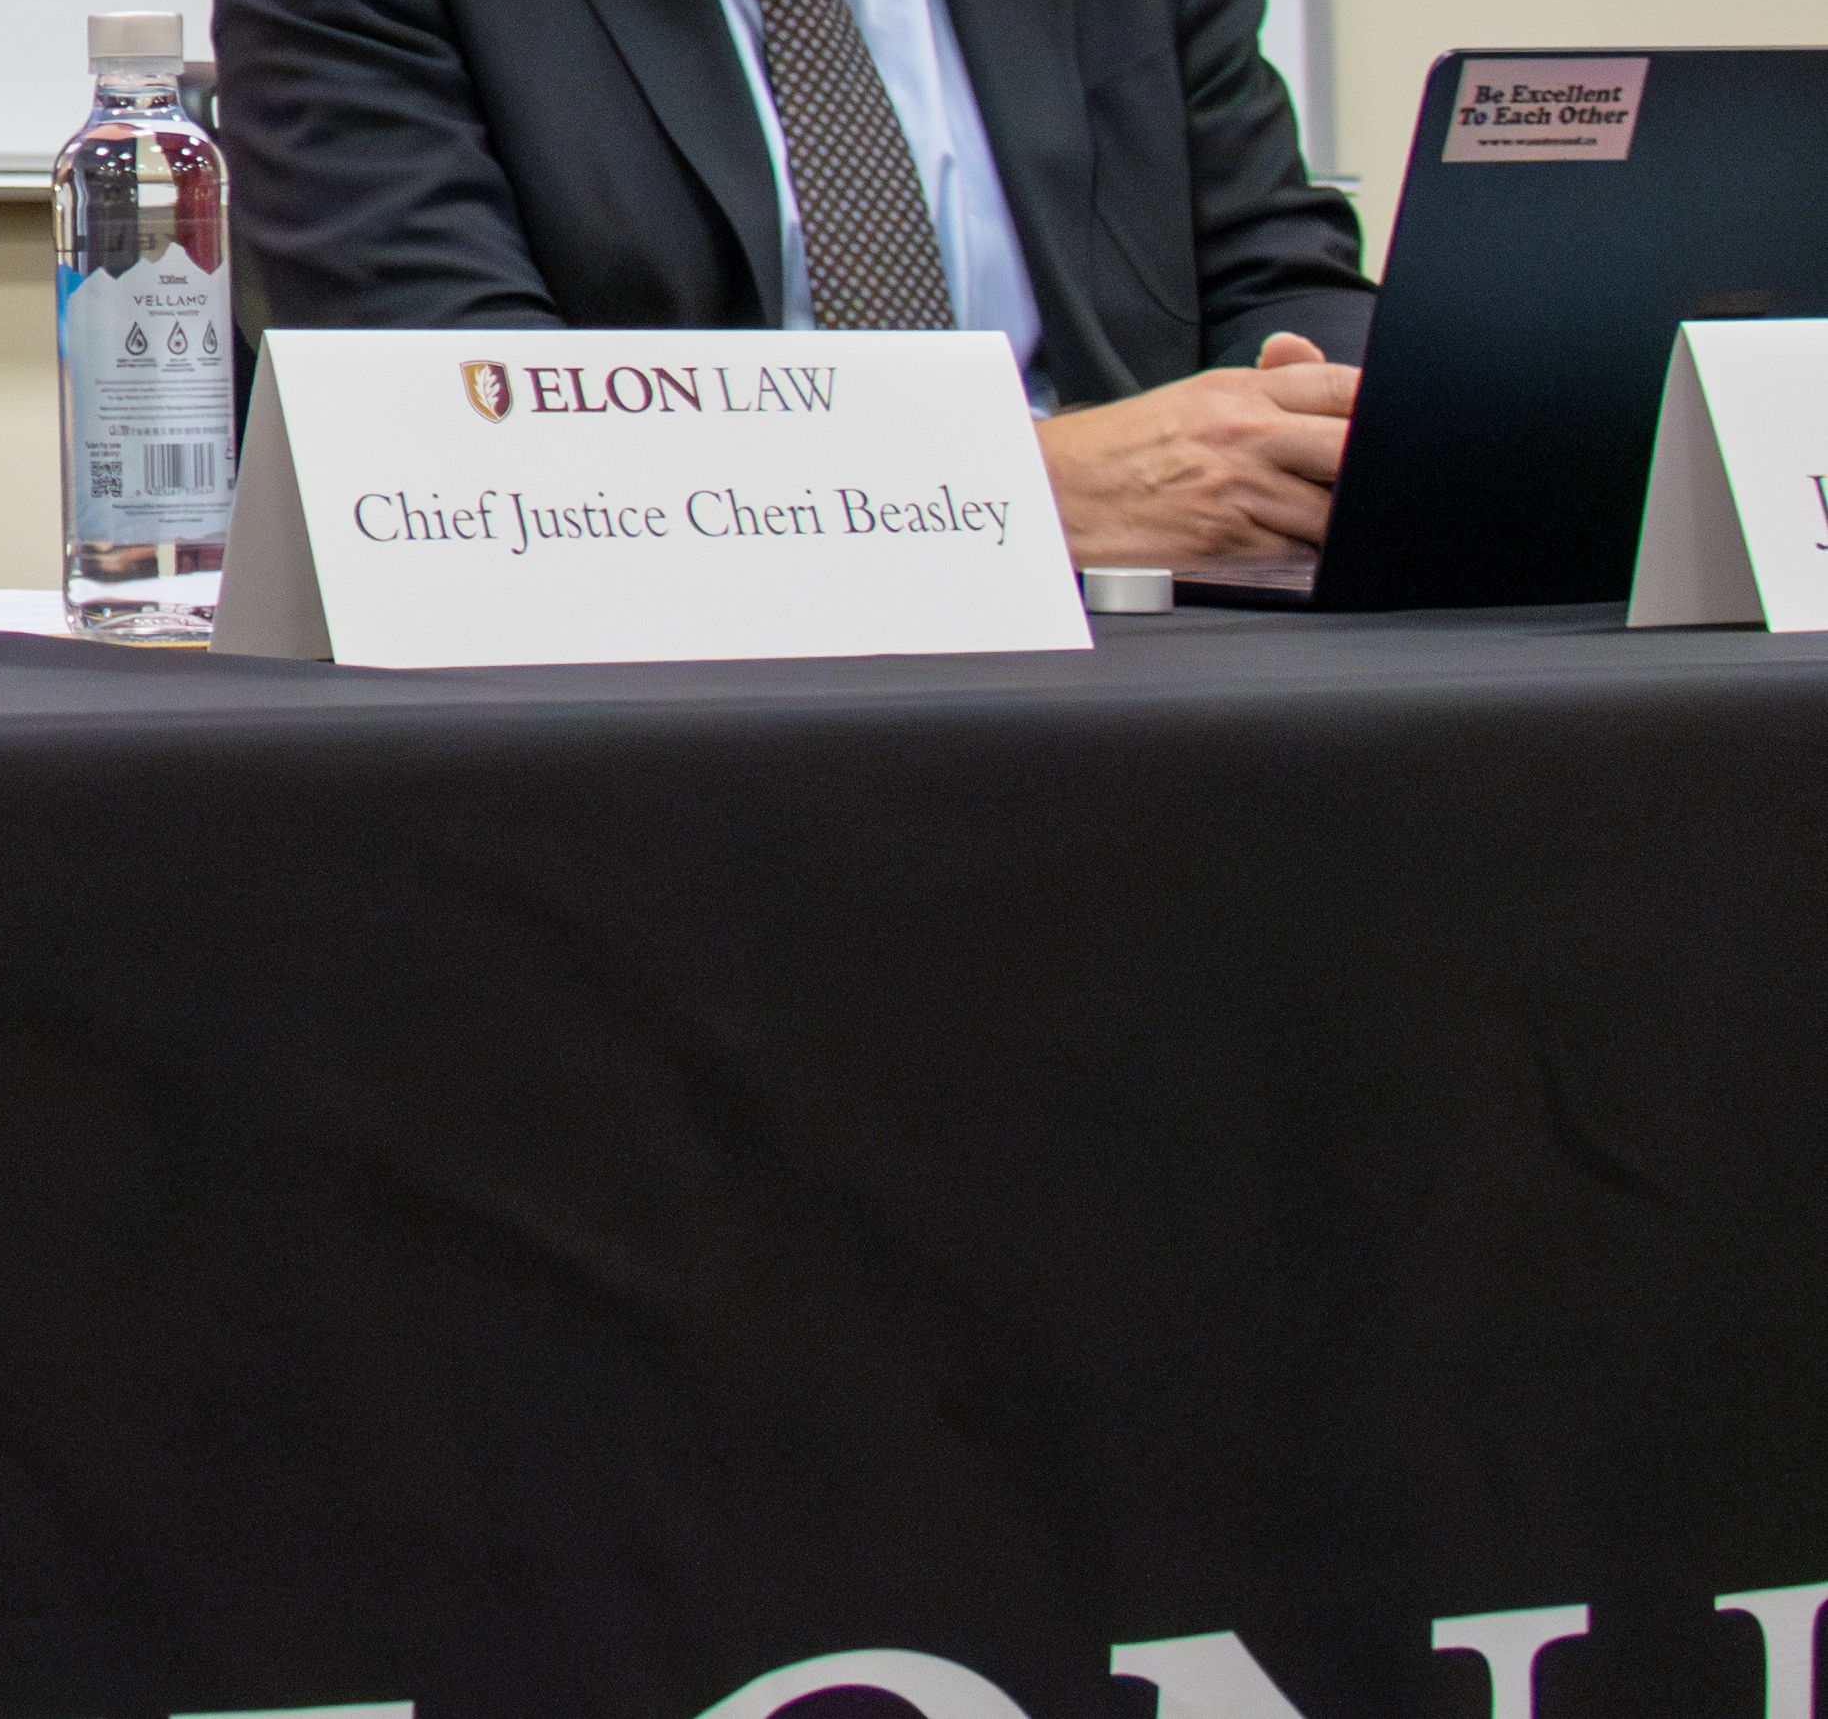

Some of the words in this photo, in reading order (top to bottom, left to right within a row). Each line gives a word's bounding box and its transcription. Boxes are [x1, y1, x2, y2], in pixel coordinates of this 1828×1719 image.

[1474, 85, 1505, 104] Be
[1511, 84, 1623, 104] Excellent
[1459, 107, 1489, 125] To
[1493, 106, 1552, 125] Each
[1558, 105, 1630, 125] Other
[132, 294, 207, 307] VELLAMO
[524, 366, 704, 414] ELON
[716, 366, 837, 413] LAW
[353, 489, 499, 542] Chief
[508, 492, 668, 556] Justice
[685, 487, 826, 538] Cheri
[834, 483, 1010, 547] Beasley
